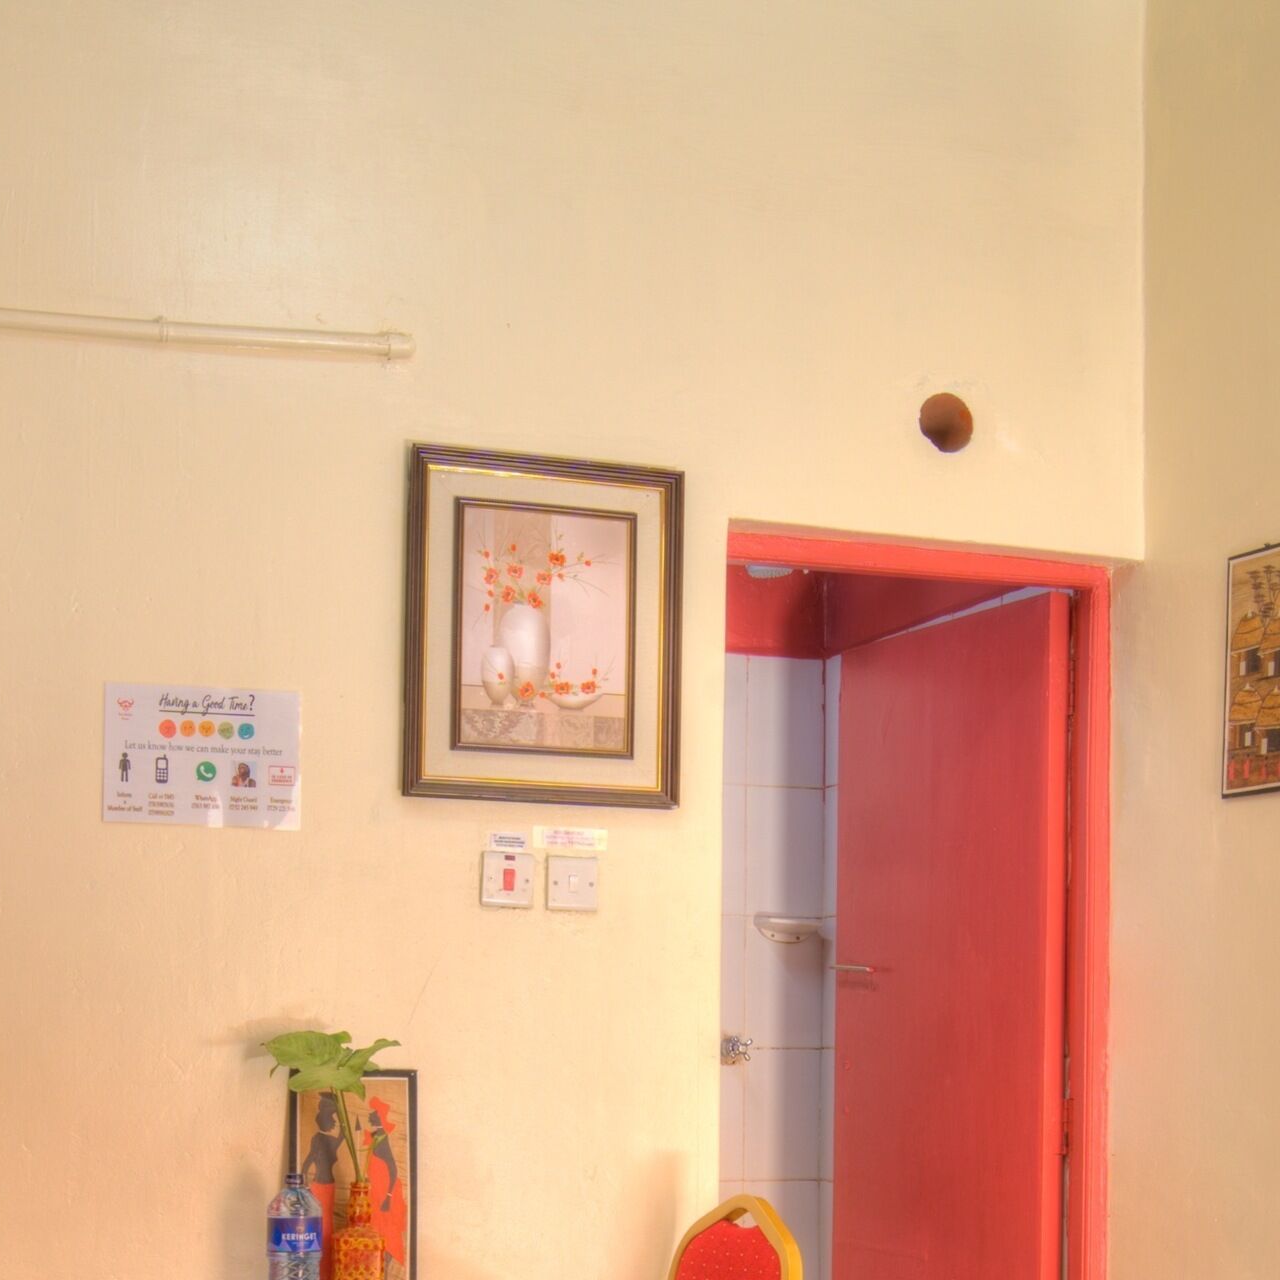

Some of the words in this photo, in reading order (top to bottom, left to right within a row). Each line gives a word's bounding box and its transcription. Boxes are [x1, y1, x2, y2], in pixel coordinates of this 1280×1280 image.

[159, 693, 190, 716] Having
[202, 694, 226, 717] Good
[229, 694, 256, 711] Time?
[125, 739, 137, 750] Let
[147, 740, 168, 751] know
[168, 741, 184, 752] how
[185, 745, 195, 753] we
[195, 745, 209, 753] can
[210, 744, 229, 754] make
[230, 746, 247, 757] your
[247, 747, 261, 758] stay
[261, 745, 283, 756] better
[281, 1231, 317, 1241] KERINGET
